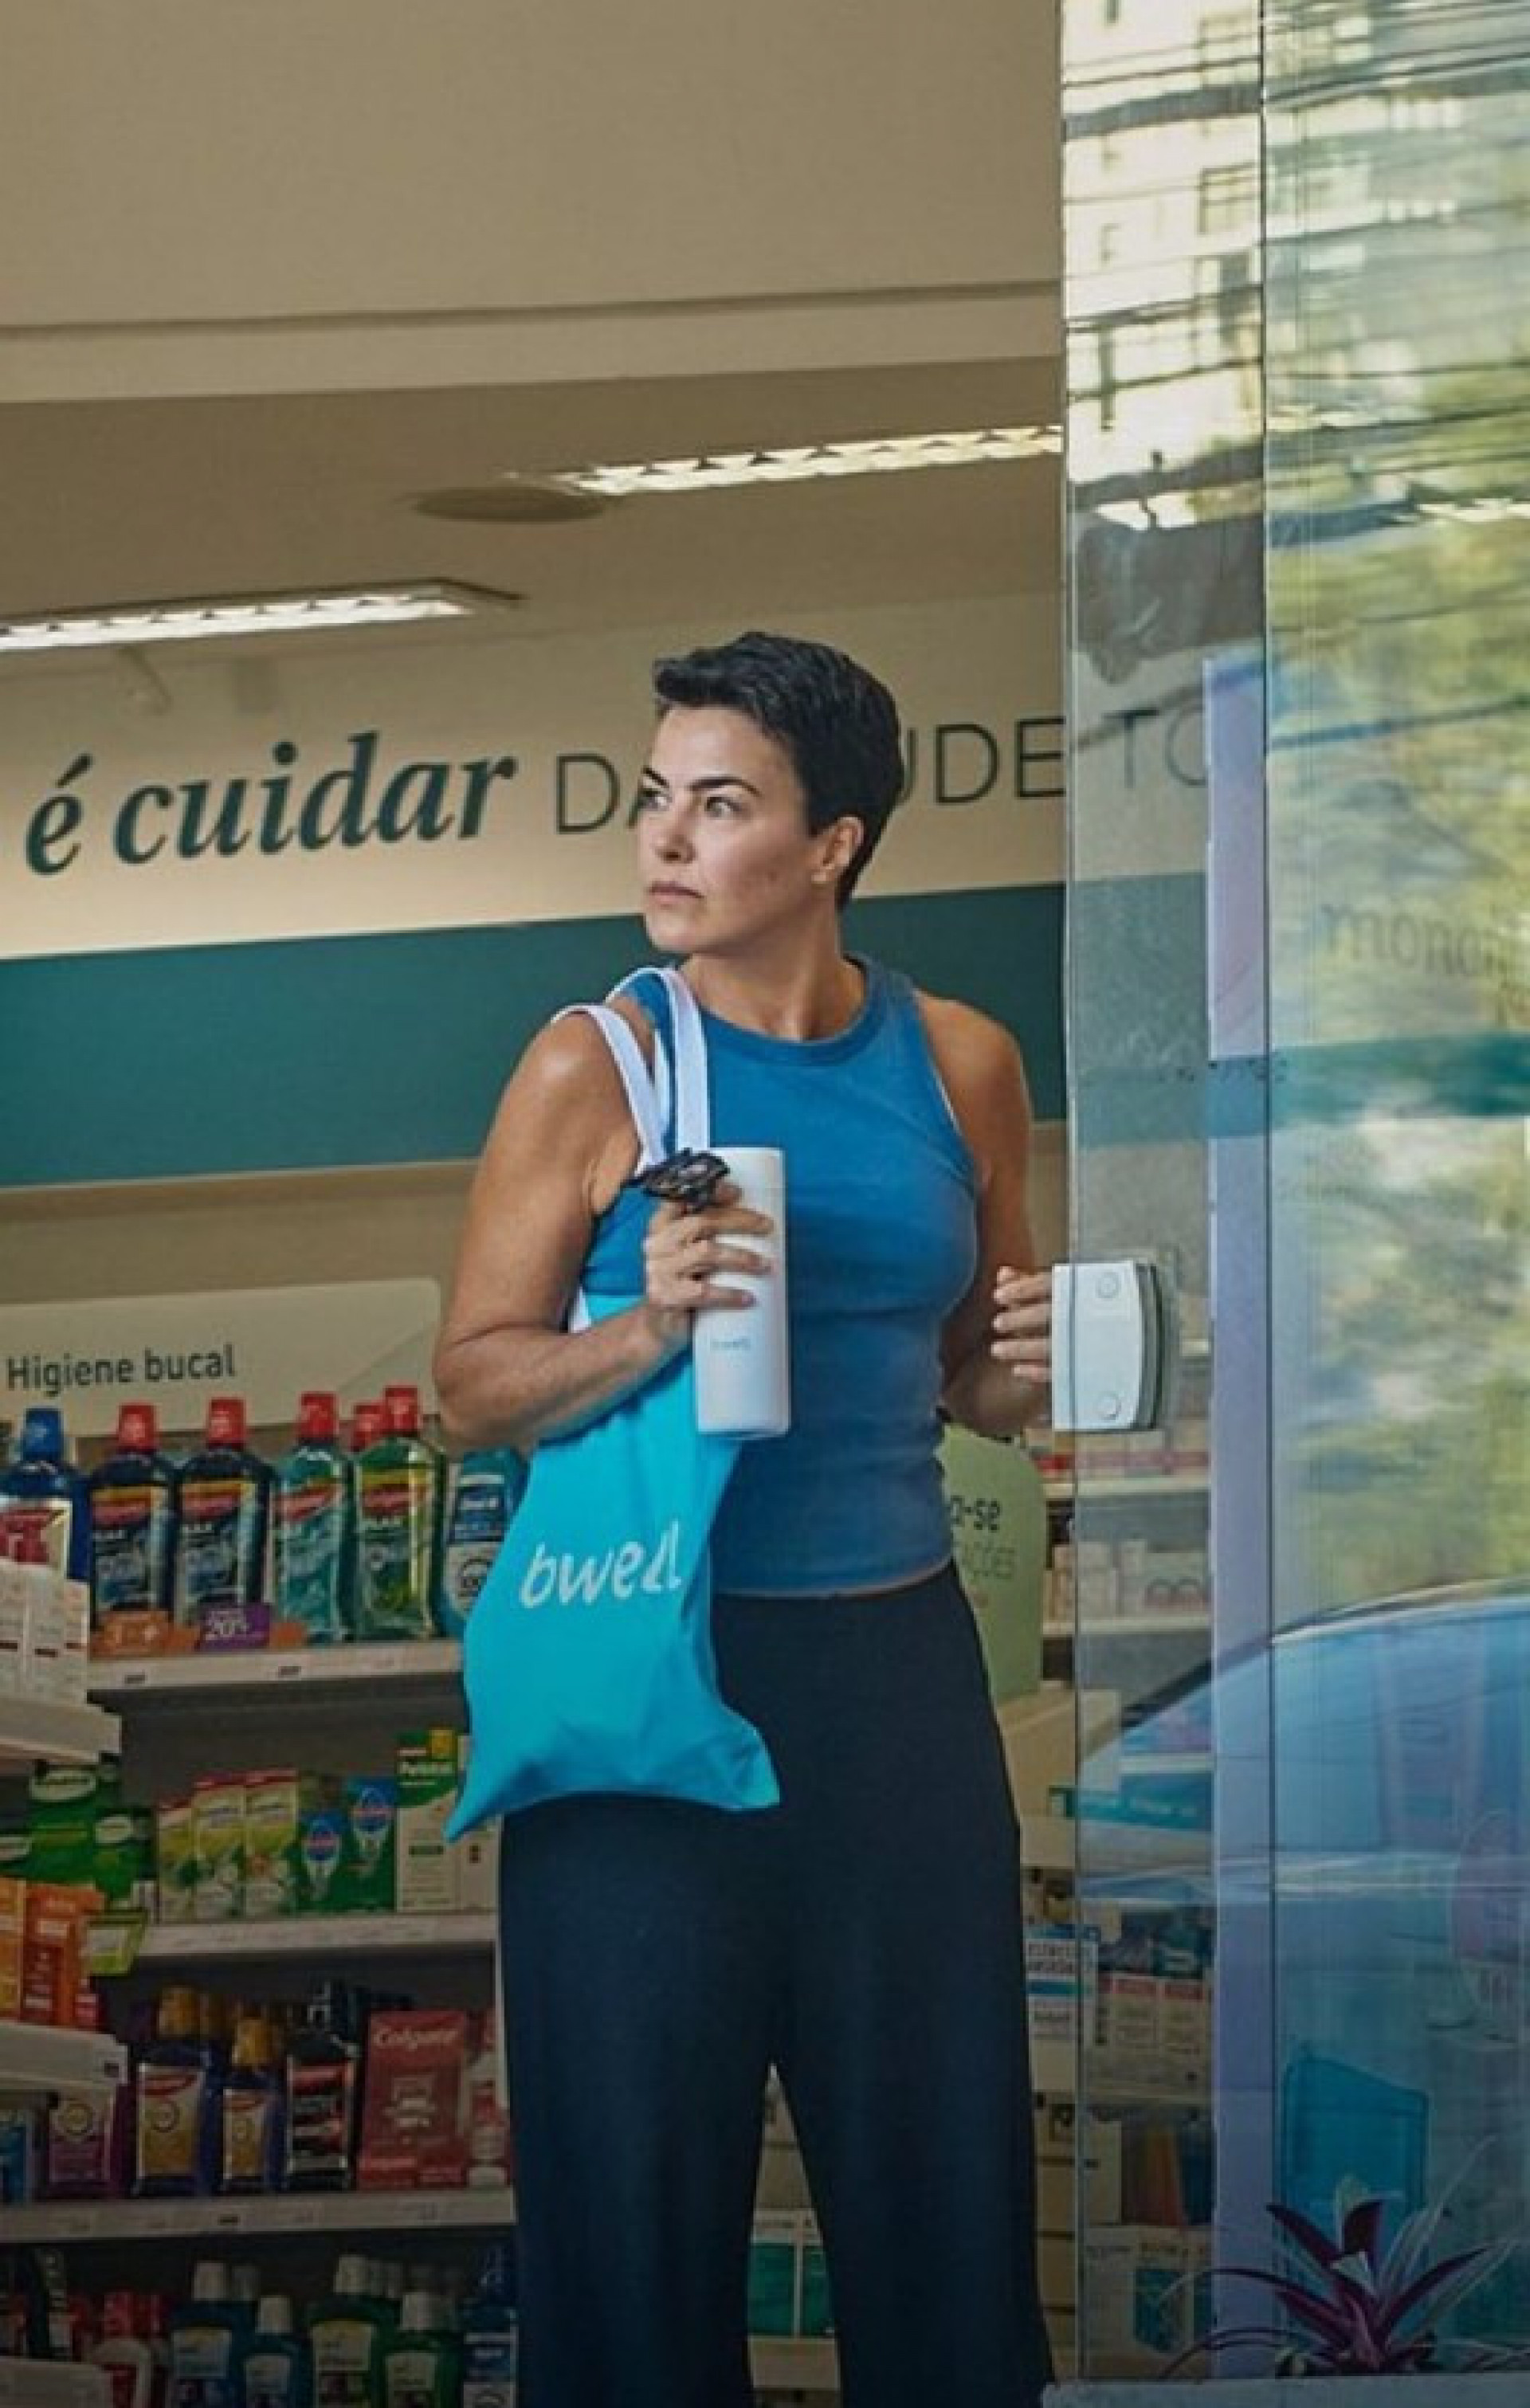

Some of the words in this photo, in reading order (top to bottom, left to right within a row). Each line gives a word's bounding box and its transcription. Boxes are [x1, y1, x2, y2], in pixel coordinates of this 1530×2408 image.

[25, 753, 92, 876] é
[113, 730, 518, 865] cuidar
[556, 753, 645, 833] D
[6, 1352, 135, 1398] Higiene
[144, 1342, 236, 1382] bucal
[519, 1519, 681, 1609] bwell
